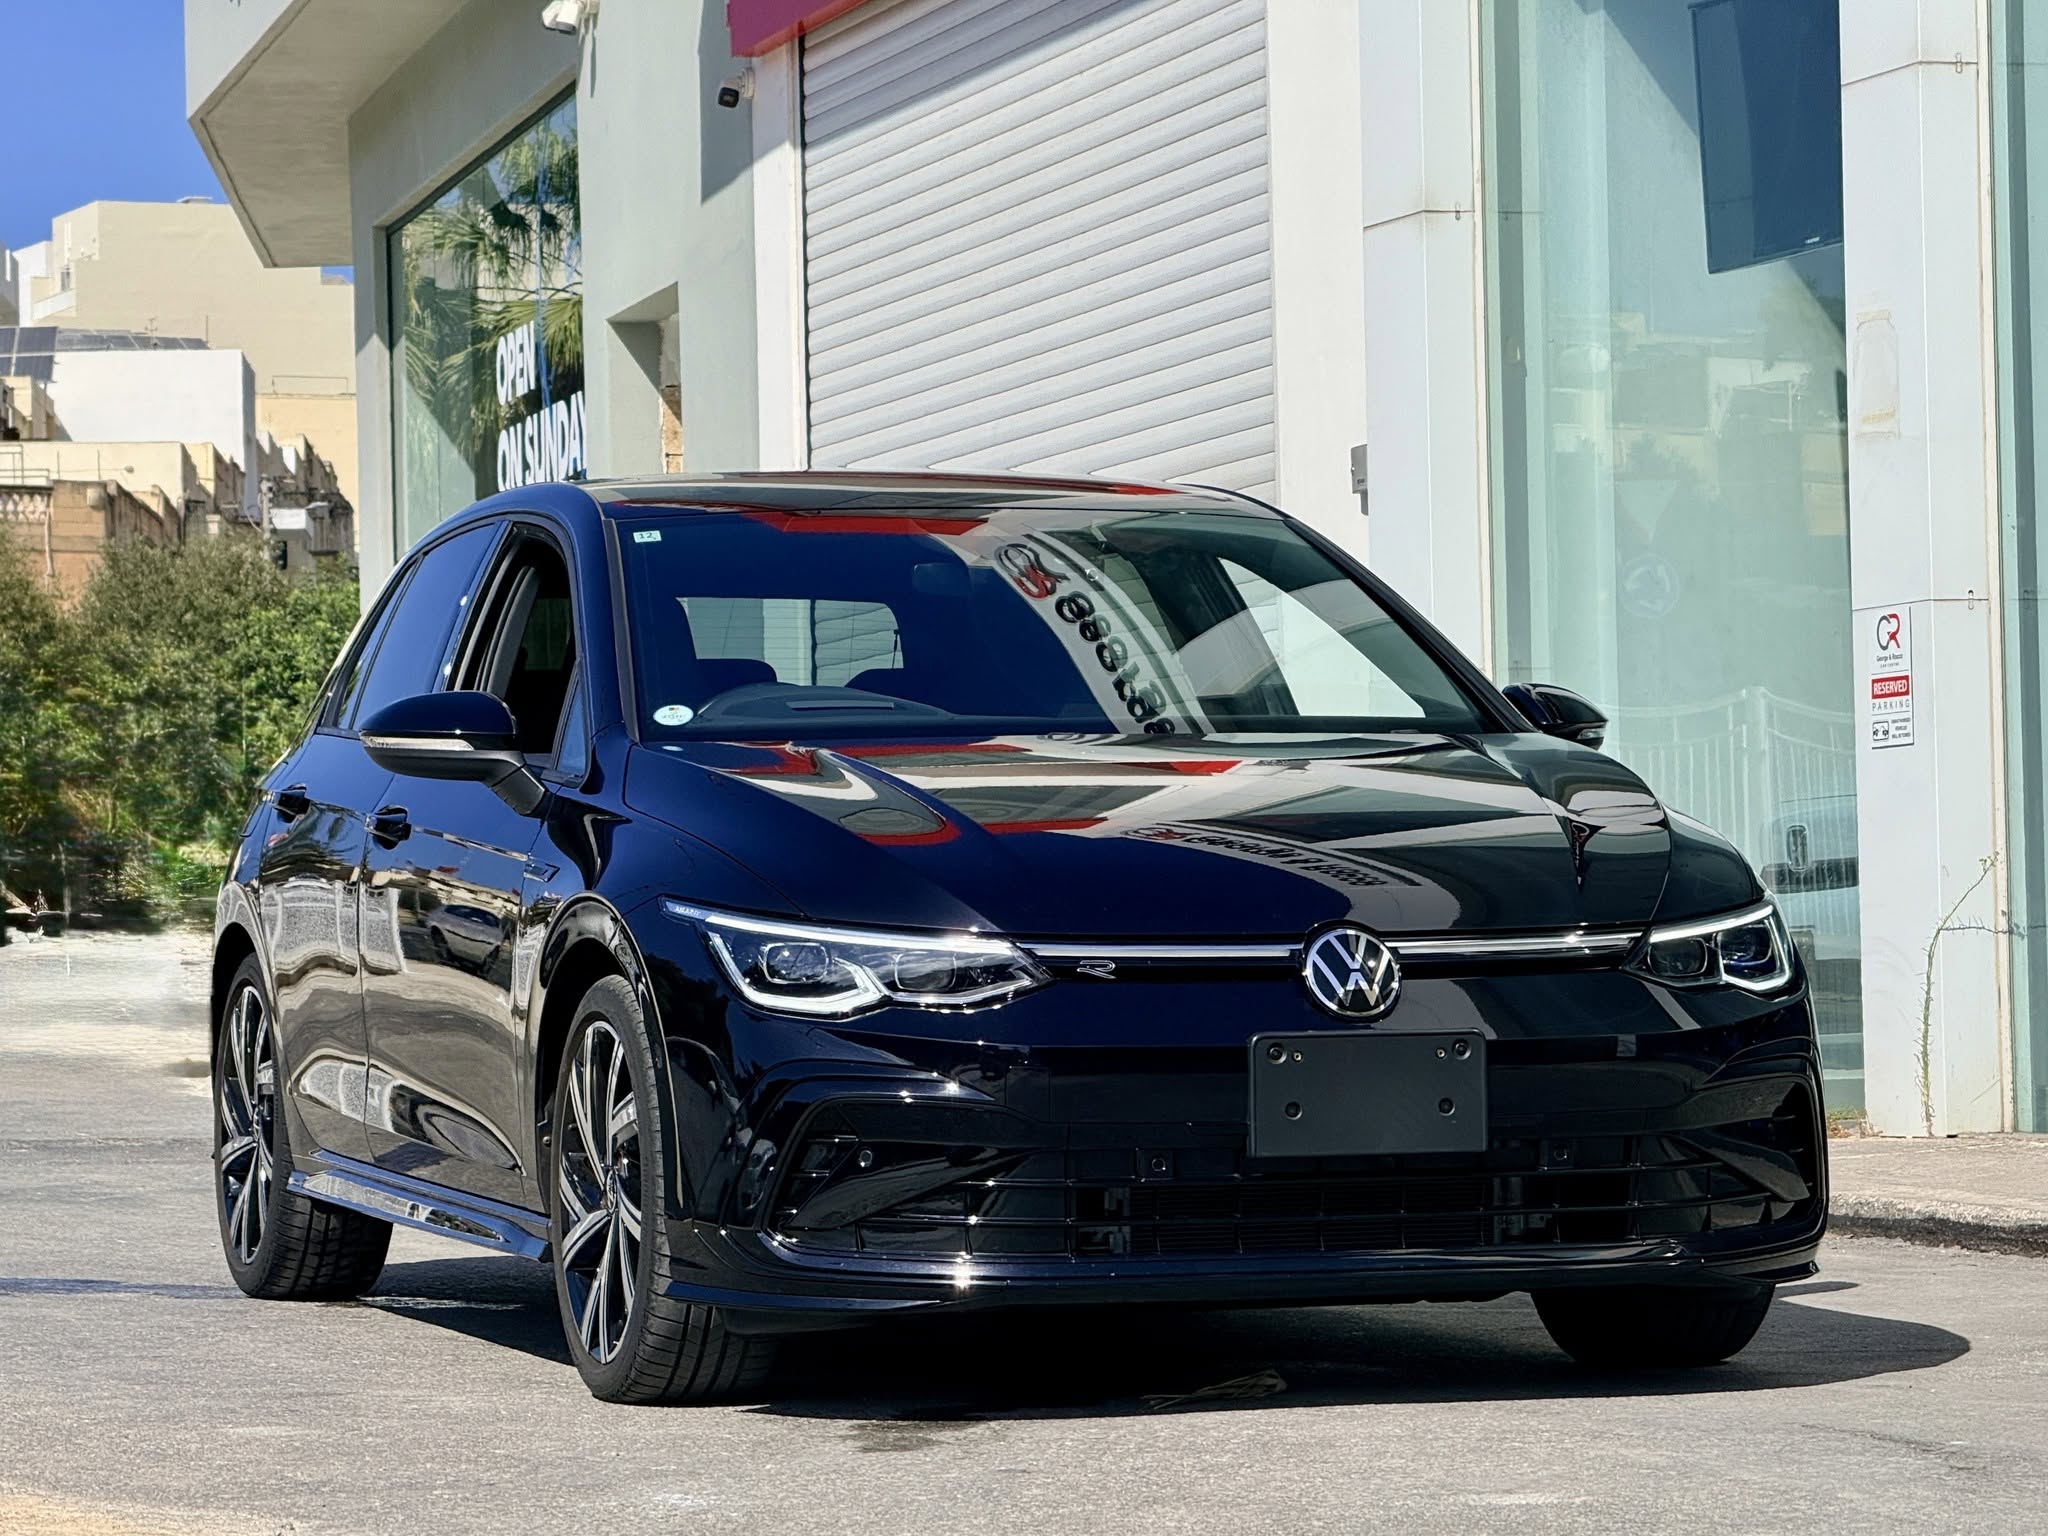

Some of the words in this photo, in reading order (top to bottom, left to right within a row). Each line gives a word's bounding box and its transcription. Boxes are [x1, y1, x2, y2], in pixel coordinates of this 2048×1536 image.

[496, 320, 536, 406] OPEN
[497, 422, 523, 492] ON
[1872, 699, 1910, 711] PARKING
[1873, 679, 1908, 695] RESERVED
